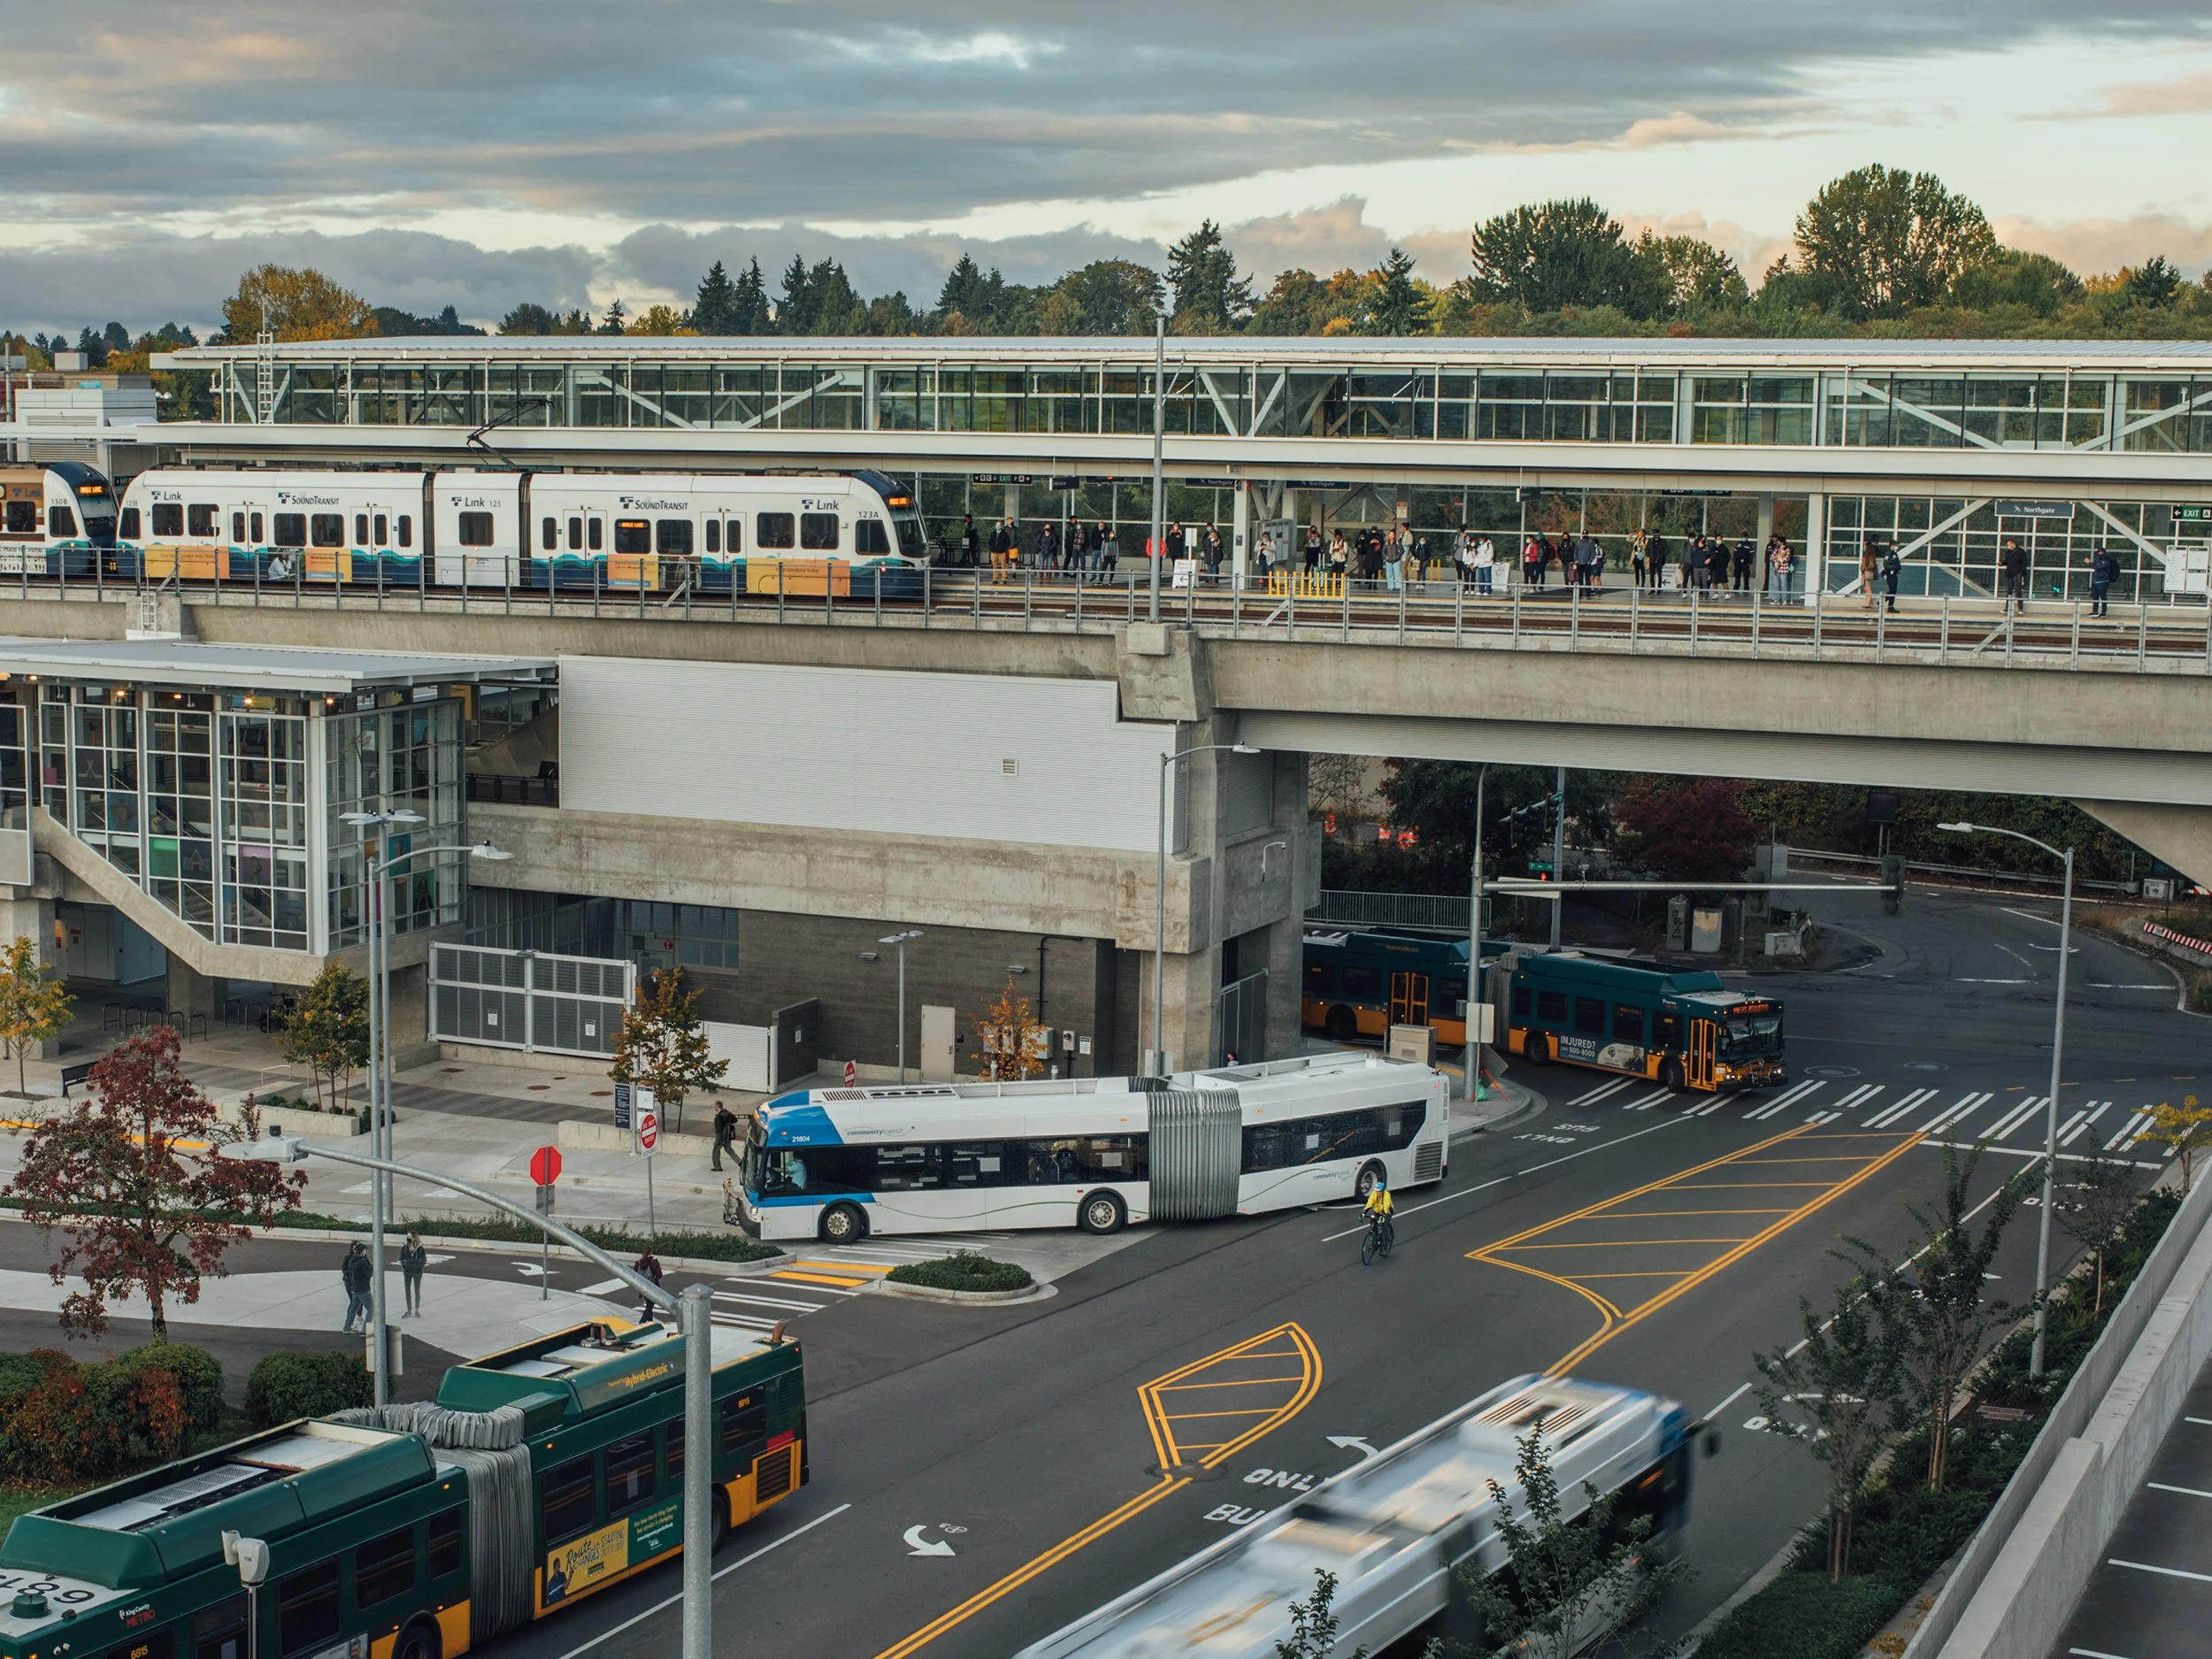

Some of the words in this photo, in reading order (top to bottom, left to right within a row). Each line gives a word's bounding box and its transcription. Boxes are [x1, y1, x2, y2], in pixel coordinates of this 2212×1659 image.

[24, 488, 42, 498] Link
[163, 491, 182, 502] Link
[465, 497, 485, 507] Link
[817, 499, 840, 511] Link
[2024, 506, 2055, 515] Northgate
[2183, 509, 2200, 518] EXIT
[1560, 1035, 1596, 1050] INJURED?
[1569, 1046, 1595, 1058] 800-8000
[1552, 1124, 1601, 1133] BUS
[644, 1134, 655, 1145] ENTER
[1512, 1133, 1576, 1143] ONLY
[625, 1363, 668, 1388] Hybrid-Electric
[1243, 1468, 1330, 1492] ONL
[1203, 1503, 1266, 1525] BU
[565, 1540, 592, 1572] Route
[126, 1607, 136, 1617] King
[135, 1602, 150, 1614] County
[127, 1609, 156, 1628] METRO
[130, 1645, 149, 1659] 6815
